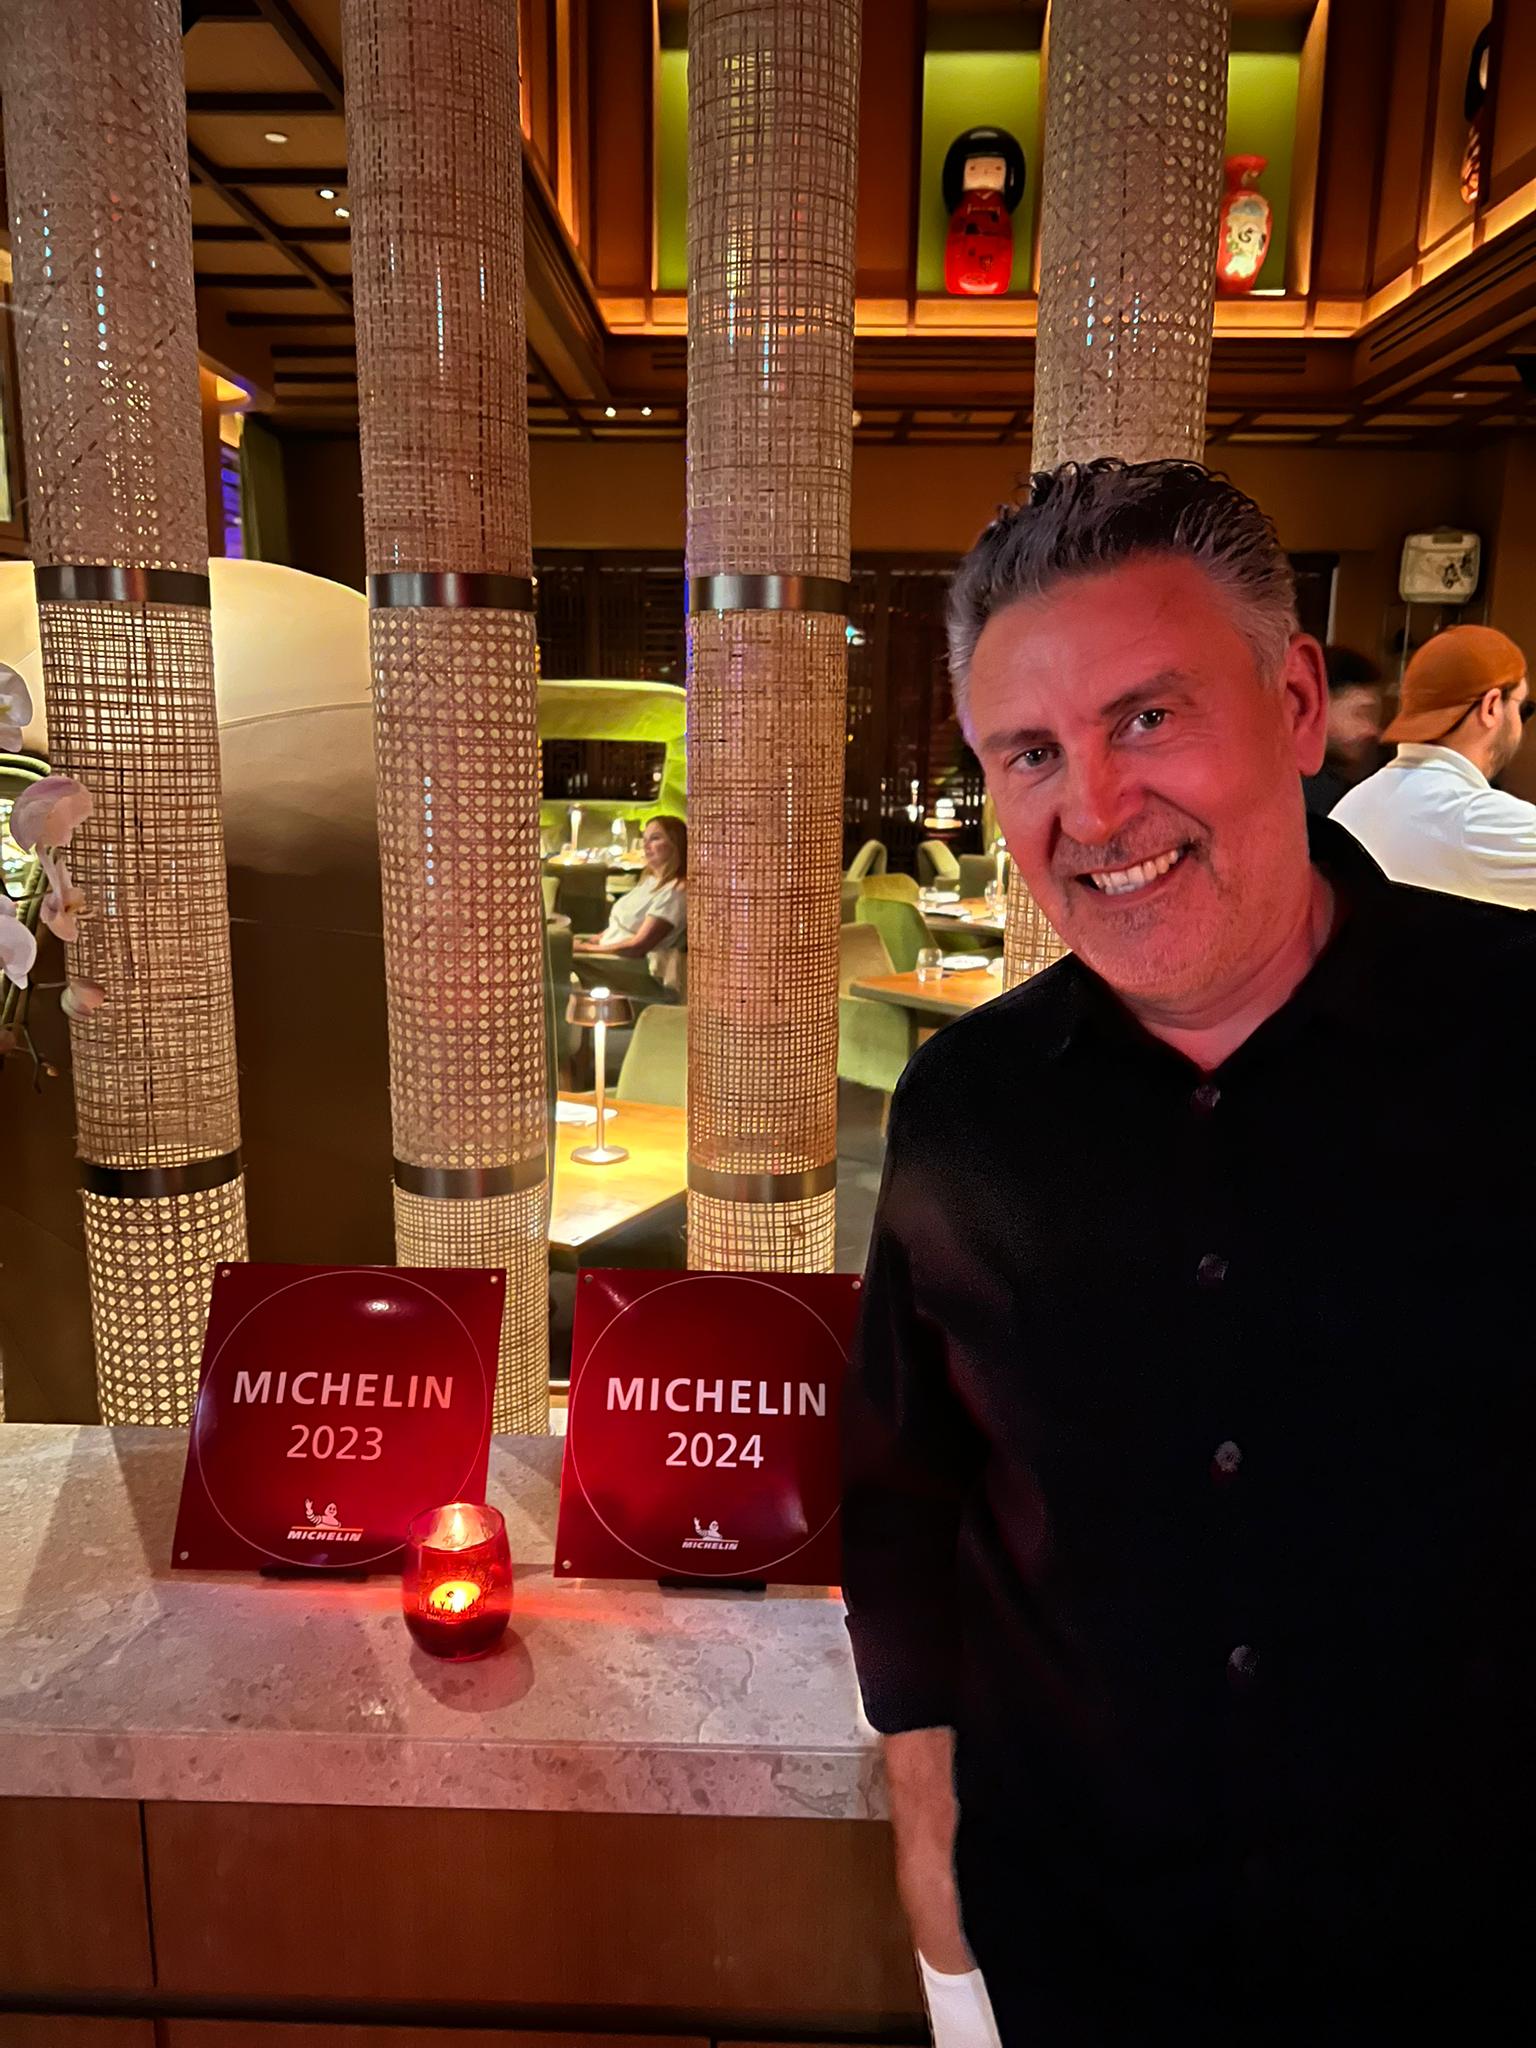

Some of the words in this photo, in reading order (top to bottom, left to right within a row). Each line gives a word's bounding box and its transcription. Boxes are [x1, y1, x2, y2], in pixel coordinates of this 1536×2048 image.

[233, 1371, 453, 1409] MICHELIN
[606, 1377, 826, 1417] MICHELIN
[286, 1424, 383, 1461] 2023
[665, 1431, 764, 1469] 2024
[287, 1530, 362, 1542] MICHELIN
[682, 1541, 738, 1550] MICHELIN
